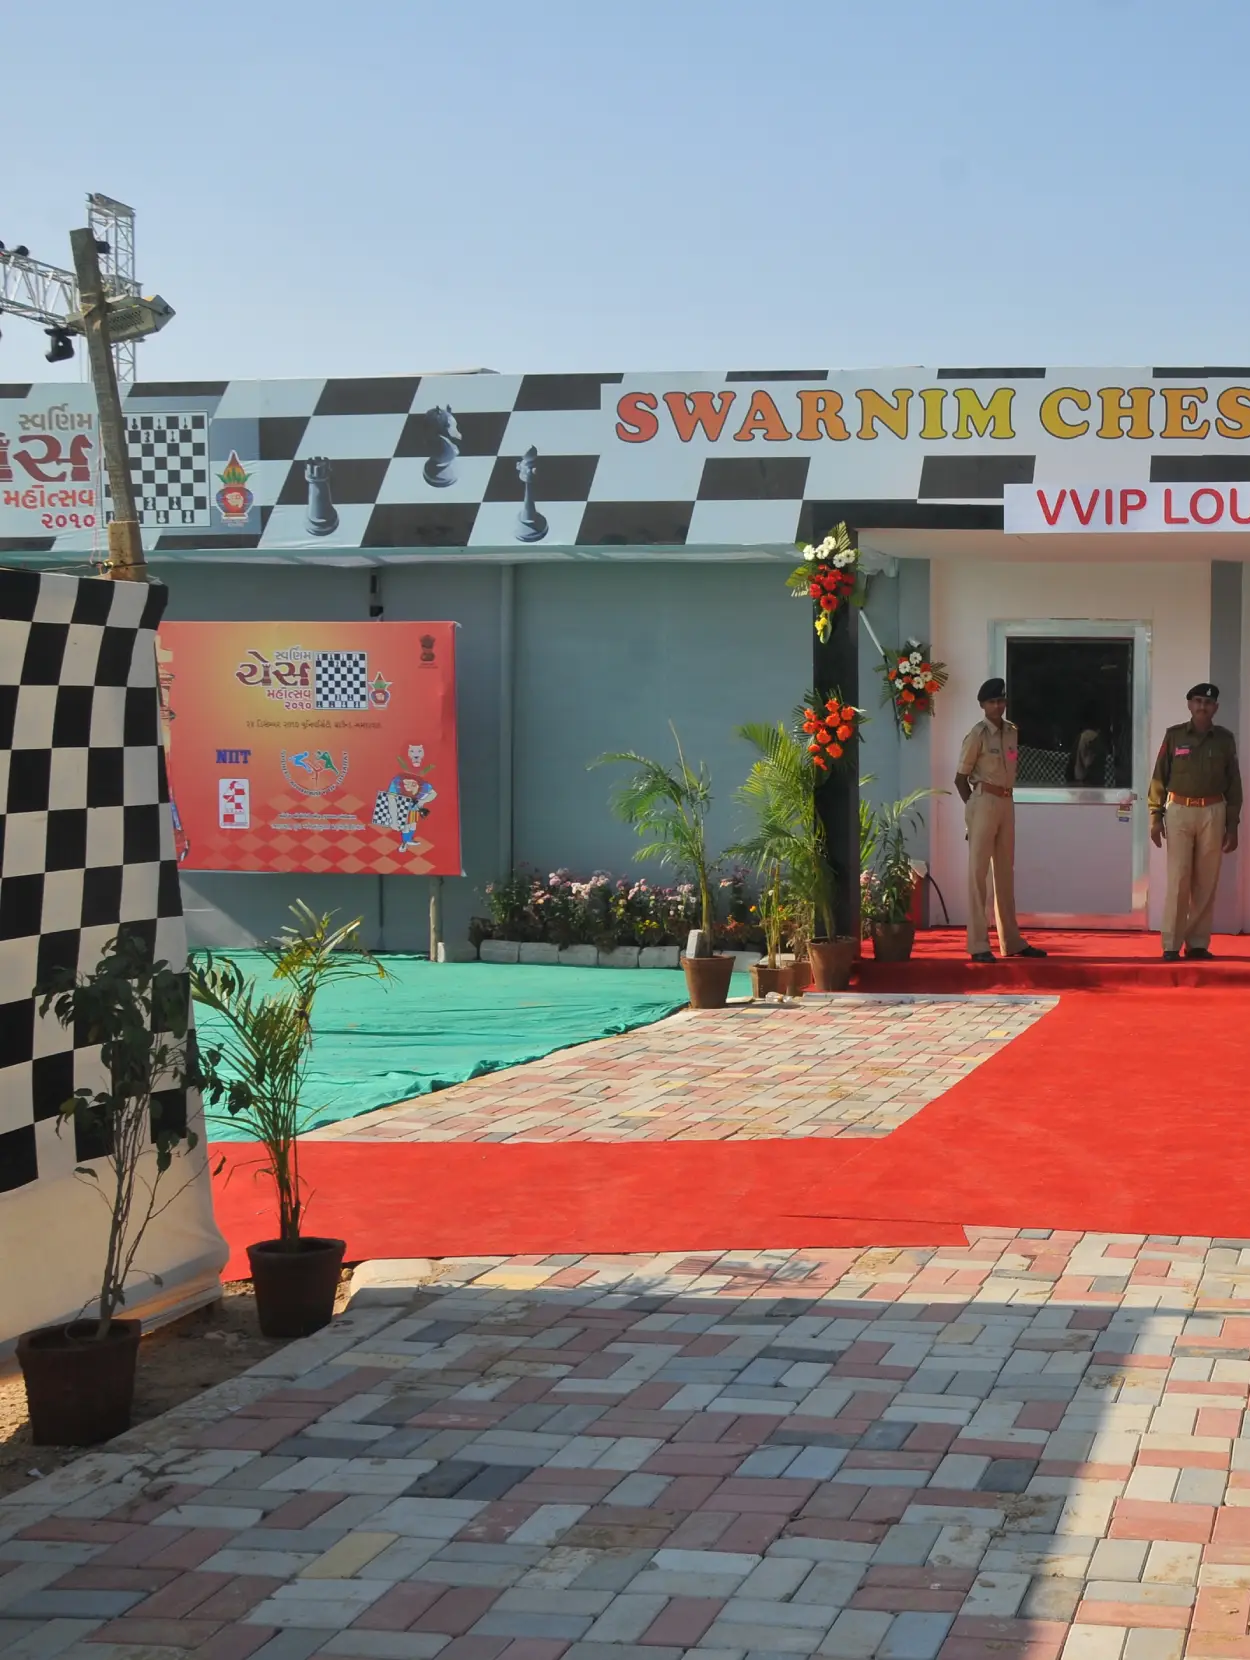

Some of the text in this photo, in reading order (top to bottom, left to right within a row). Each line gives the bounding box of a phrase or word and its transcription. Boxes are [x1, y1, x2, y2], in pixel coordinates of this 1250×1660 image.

[18, 403, 93, 431] સ્વર્ણિમ
[615, 387, 1016, 443] SWARNIM
[1036, 488, 1147, 526] VVIP
[41, 513, 96, 530] ૨૦૧૦
[284, 701, 312, 710] ૨૦૧૦
[215, 749, 252, 764] NIIT
